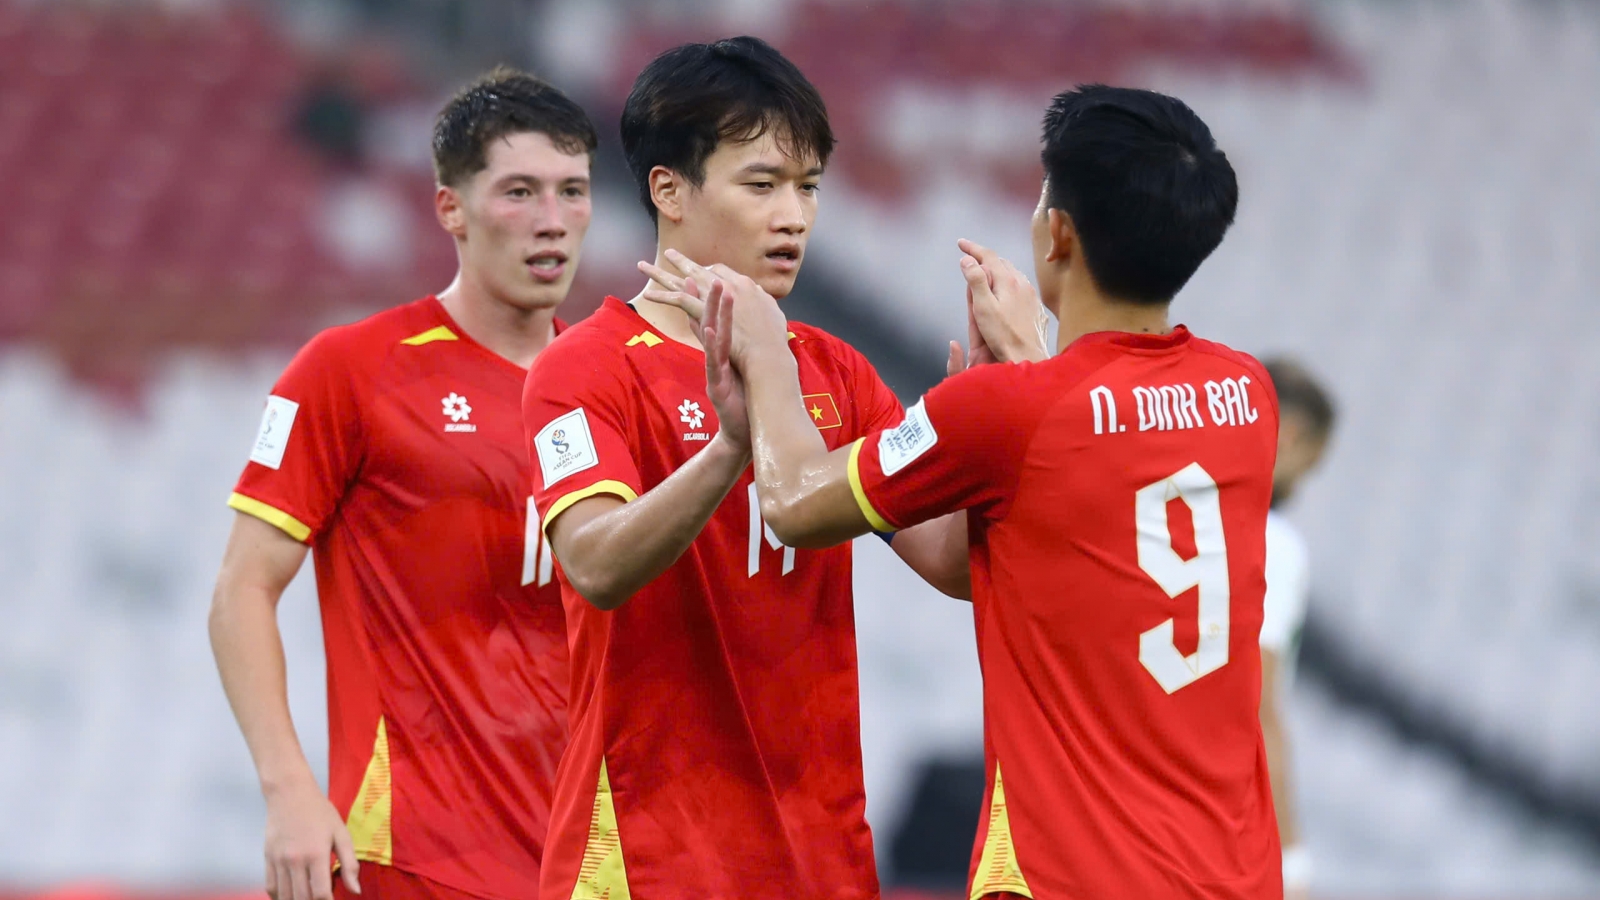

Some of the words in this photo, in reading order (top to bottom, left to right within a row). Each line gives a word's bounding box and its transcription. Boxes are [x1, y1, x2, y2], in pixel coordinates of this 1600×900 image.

[1089, 385, 1126, 434] N.
[1132, 383, 1204, 431] DINH
[1204, 375, 1258, 426] BAC
[1135, 461, 1230, 695] 9
